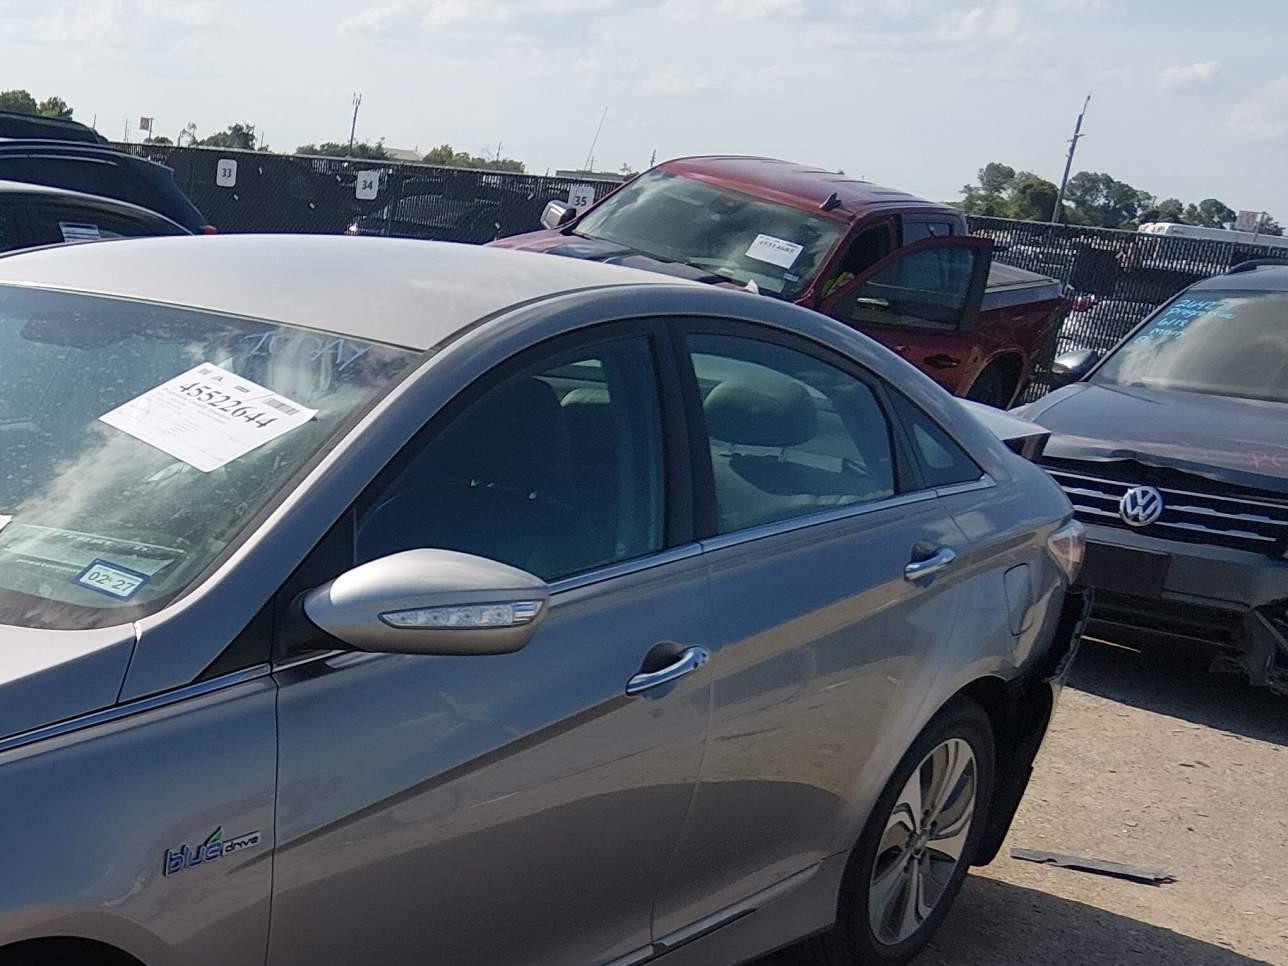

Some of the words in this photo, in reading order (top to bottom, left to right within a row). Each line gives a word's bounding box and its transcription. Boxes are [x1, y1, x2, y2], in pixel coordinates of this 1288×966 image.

[221, 168, 232, 178] 33
[361, 180, 373, 190] 34
[574, 195, 587, 207] 35
[244, 329, 375, 371] TODAY
[178, 381, 280, 429] 45522644
[1121, 487, 1161, 526] VW
[87, 571, 110, 585] 02
[111, 579, 137, 592] 27
[164, 838, 223, 876] blue
